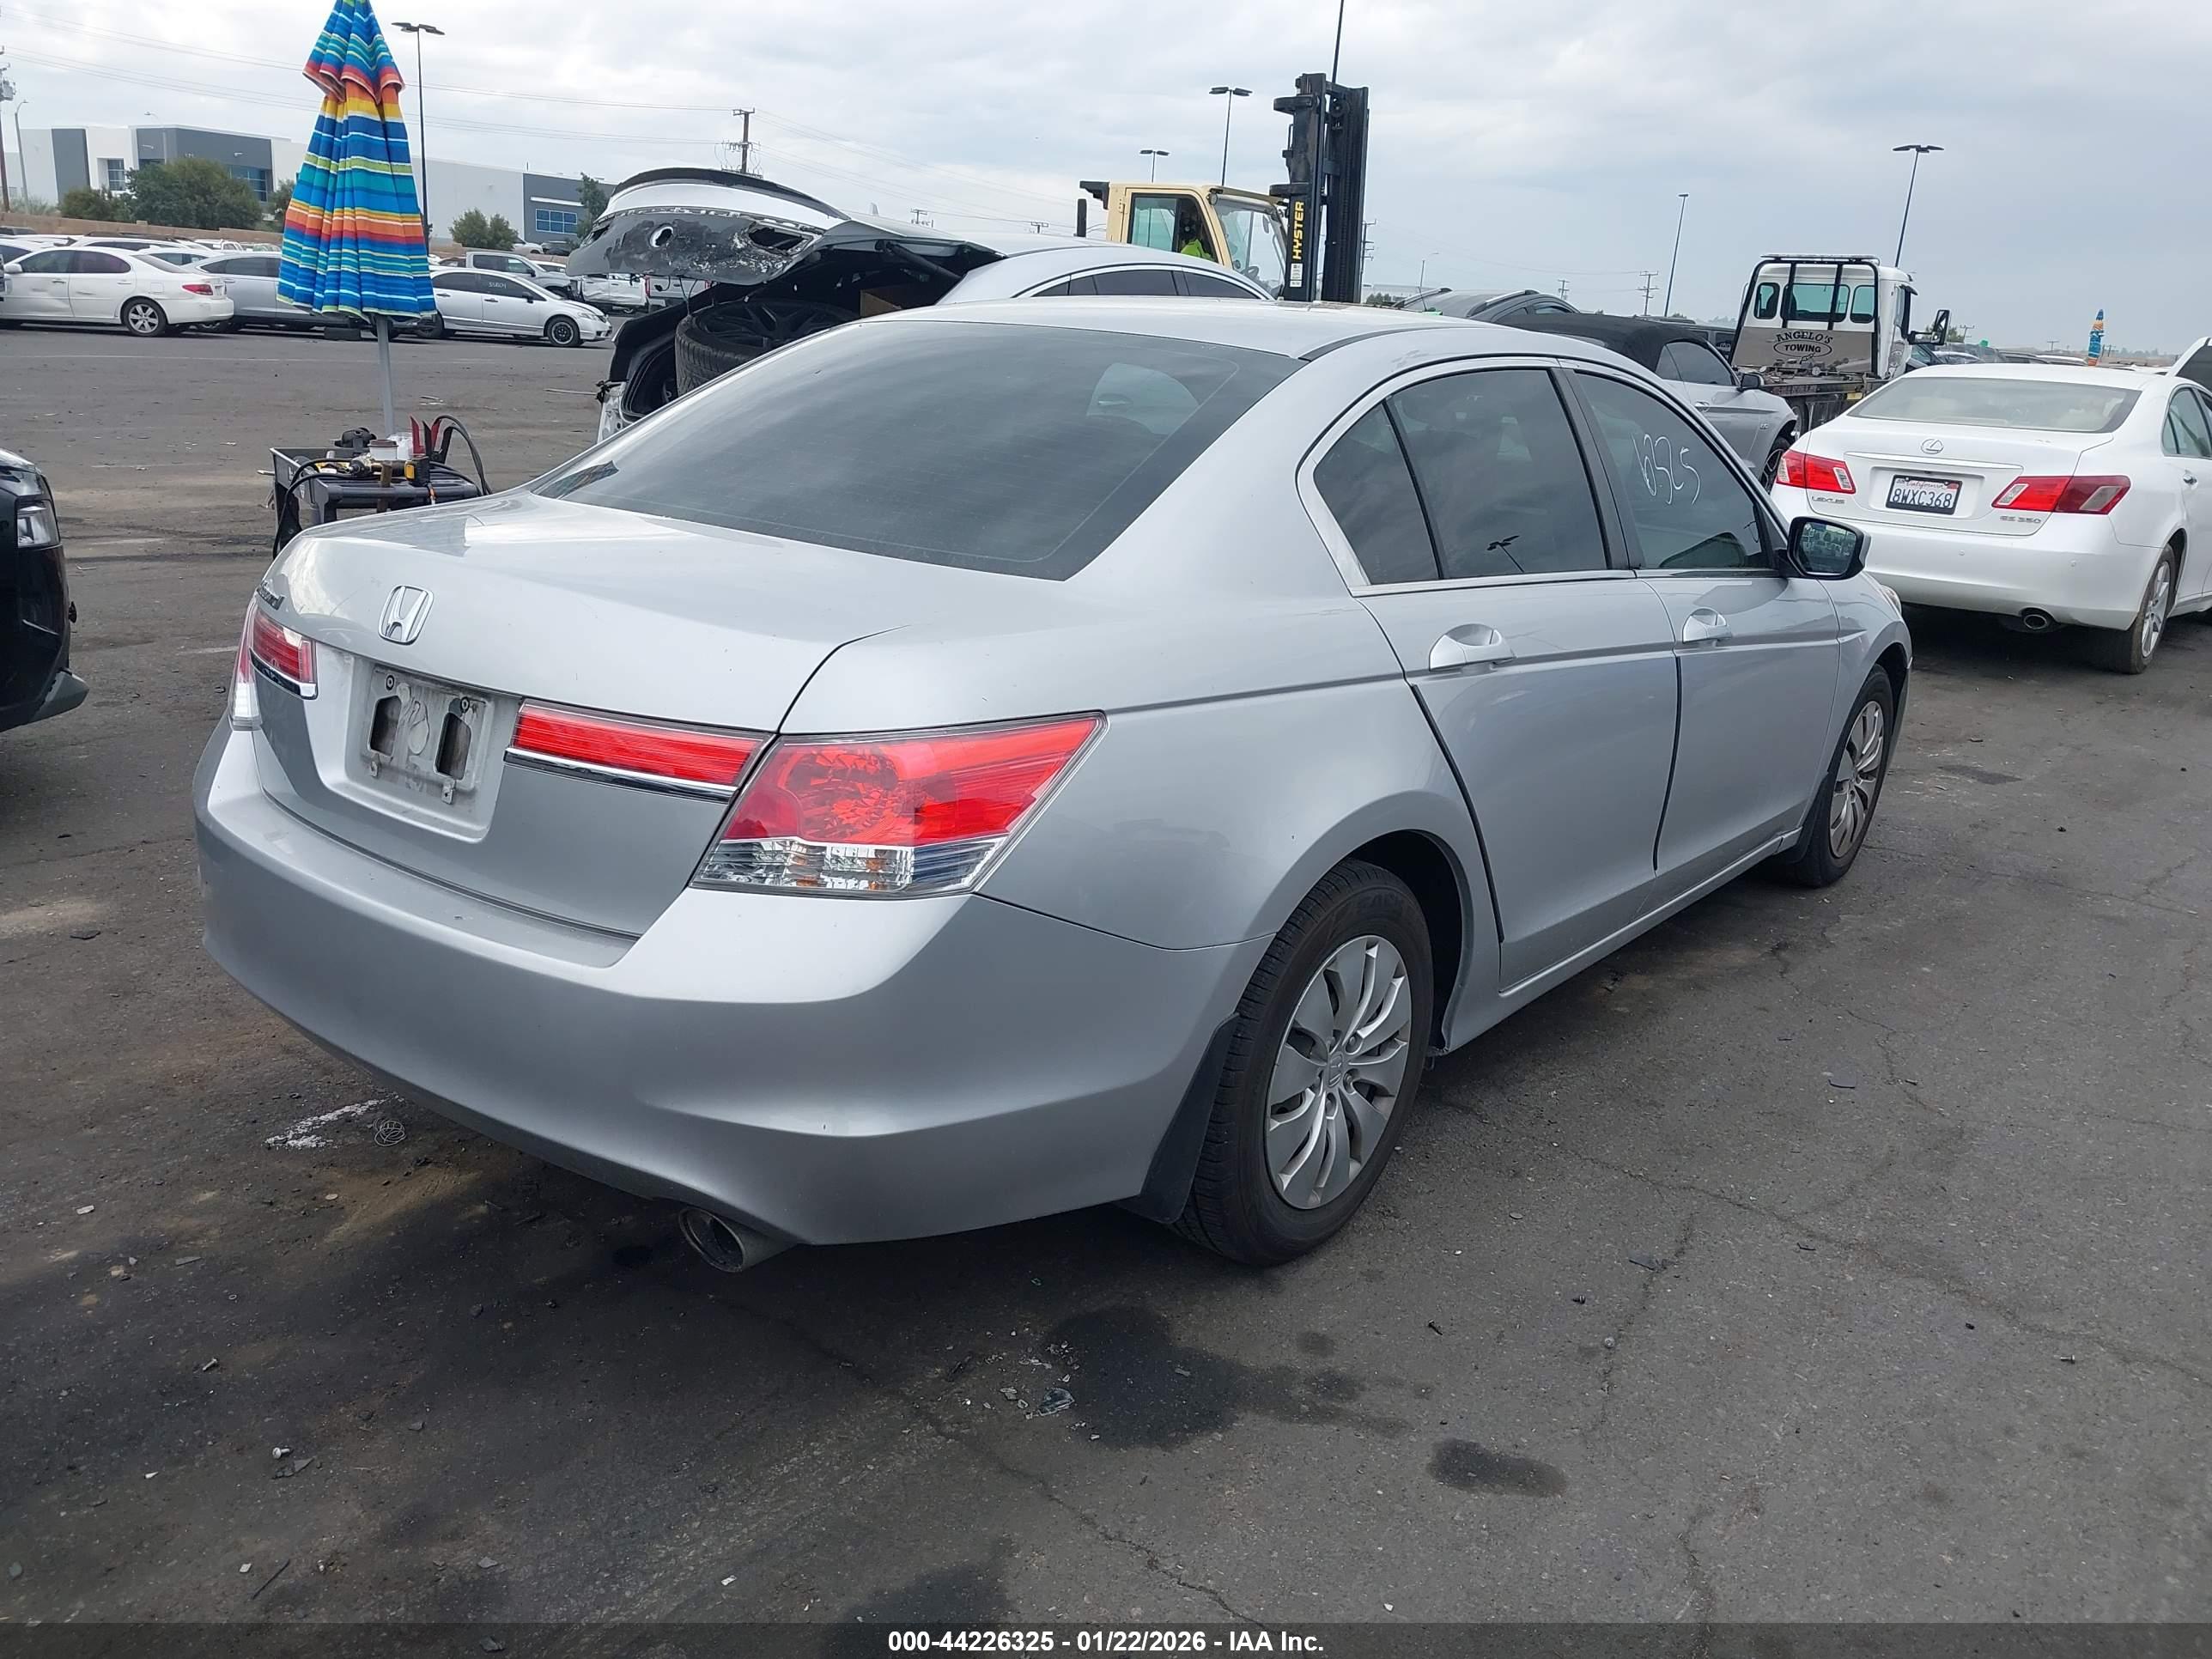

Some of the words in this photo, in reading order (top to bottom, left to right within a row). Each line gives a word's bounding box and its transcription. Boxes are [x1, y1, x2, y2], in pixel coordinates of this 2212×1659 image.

[1292, 201, 1304, 260] HYSTER
[1776, 331, 1833, 344] ANGELO'S
[1784, 343, 1821, 353] TOWING
[1893, 488, 1953, 508] 8WXC368
